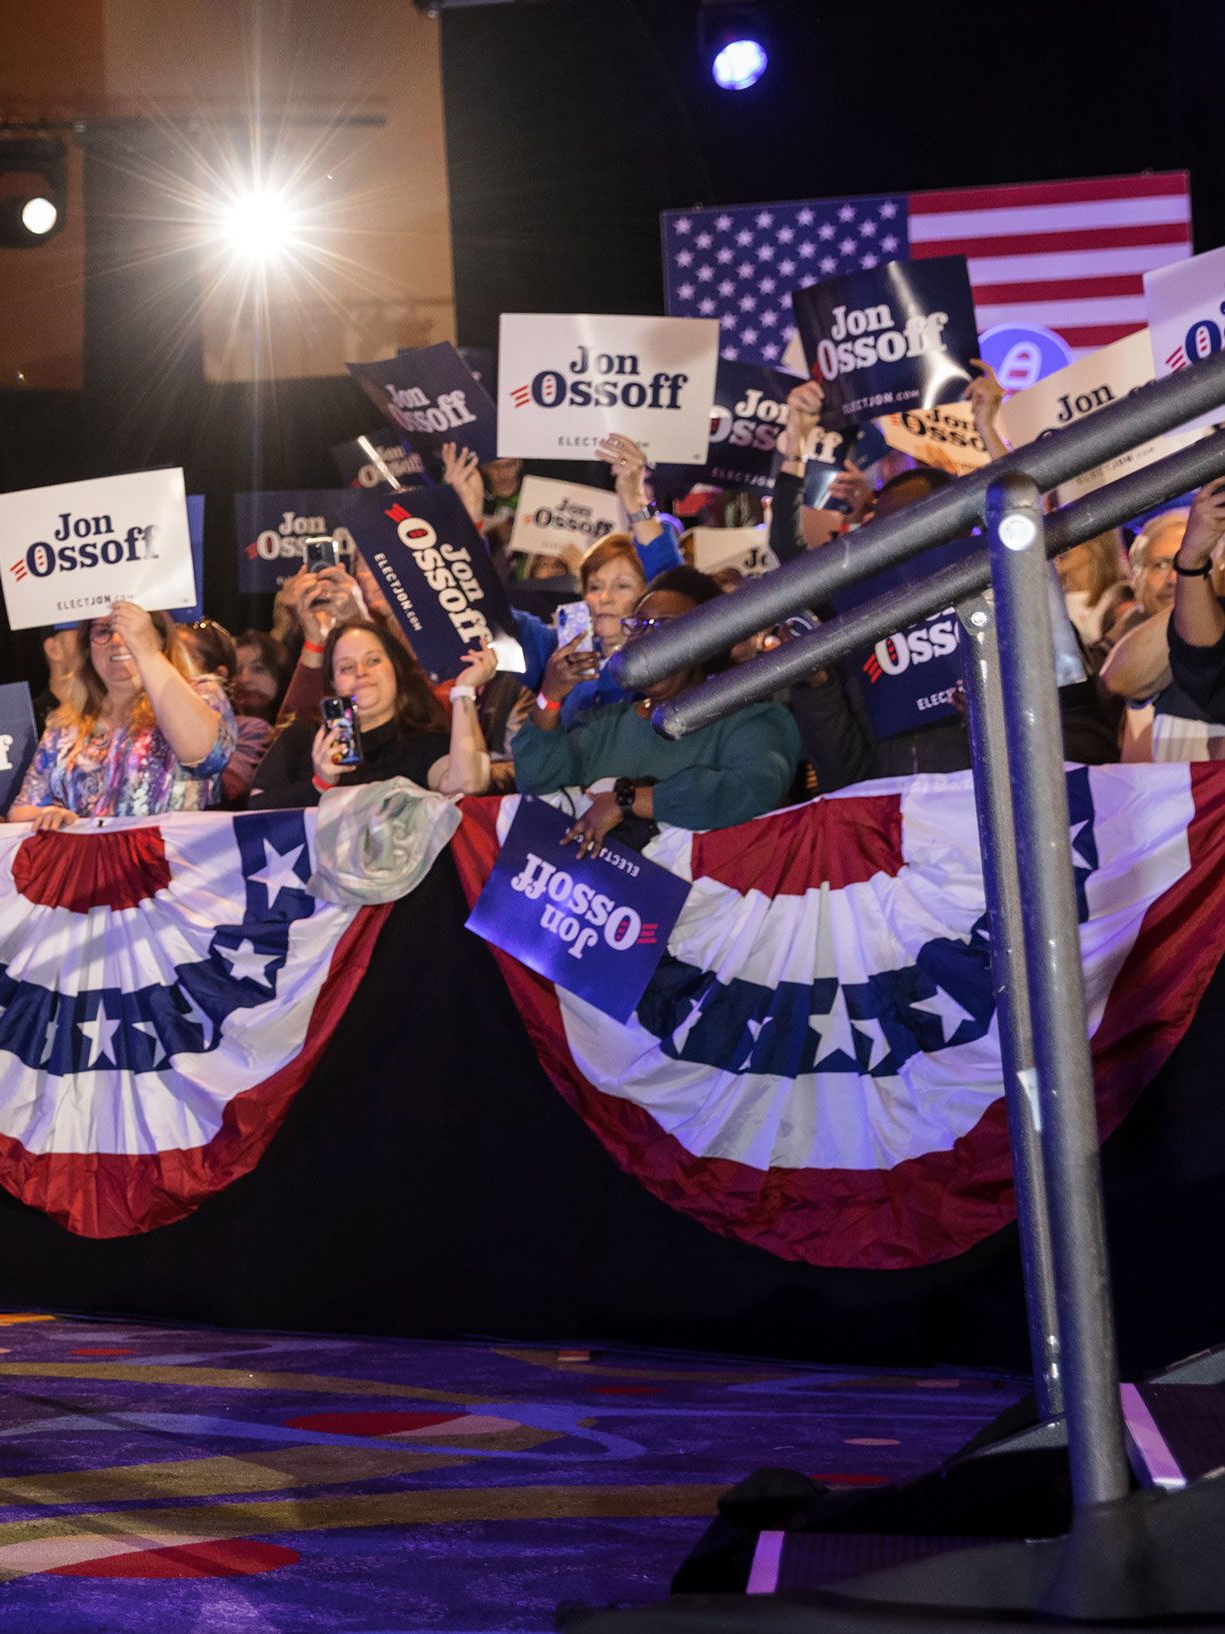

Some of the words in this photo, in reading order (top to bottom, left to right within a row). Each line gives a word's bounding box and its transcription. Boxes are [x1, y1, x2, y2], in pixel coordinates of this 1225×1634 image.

[831, 304, 895, 341] Jon
[570, 345, 640, 375] Jon
[817, 311, 949, 381] Ossoff
[531, 370, 688, 409] Ossoff
[1057, 384, 1115, 422] Jon
[901, 412, 987, 452] Osso
[711, 466, 775, 489] ELECTJON
[55, 512, 115, 541] Jon
[278, 511, 326, 535] Jon
[26, 524, 160, 578] Ossoff
[397, 517, 494, 644] Ossoff
[439, 543, 485, 602] Jon
[56, 594, 135, 611] ELECTJONCOM
[510, 852, 641, 951] Ossoff
[540, 903, 599, 959] Jon
